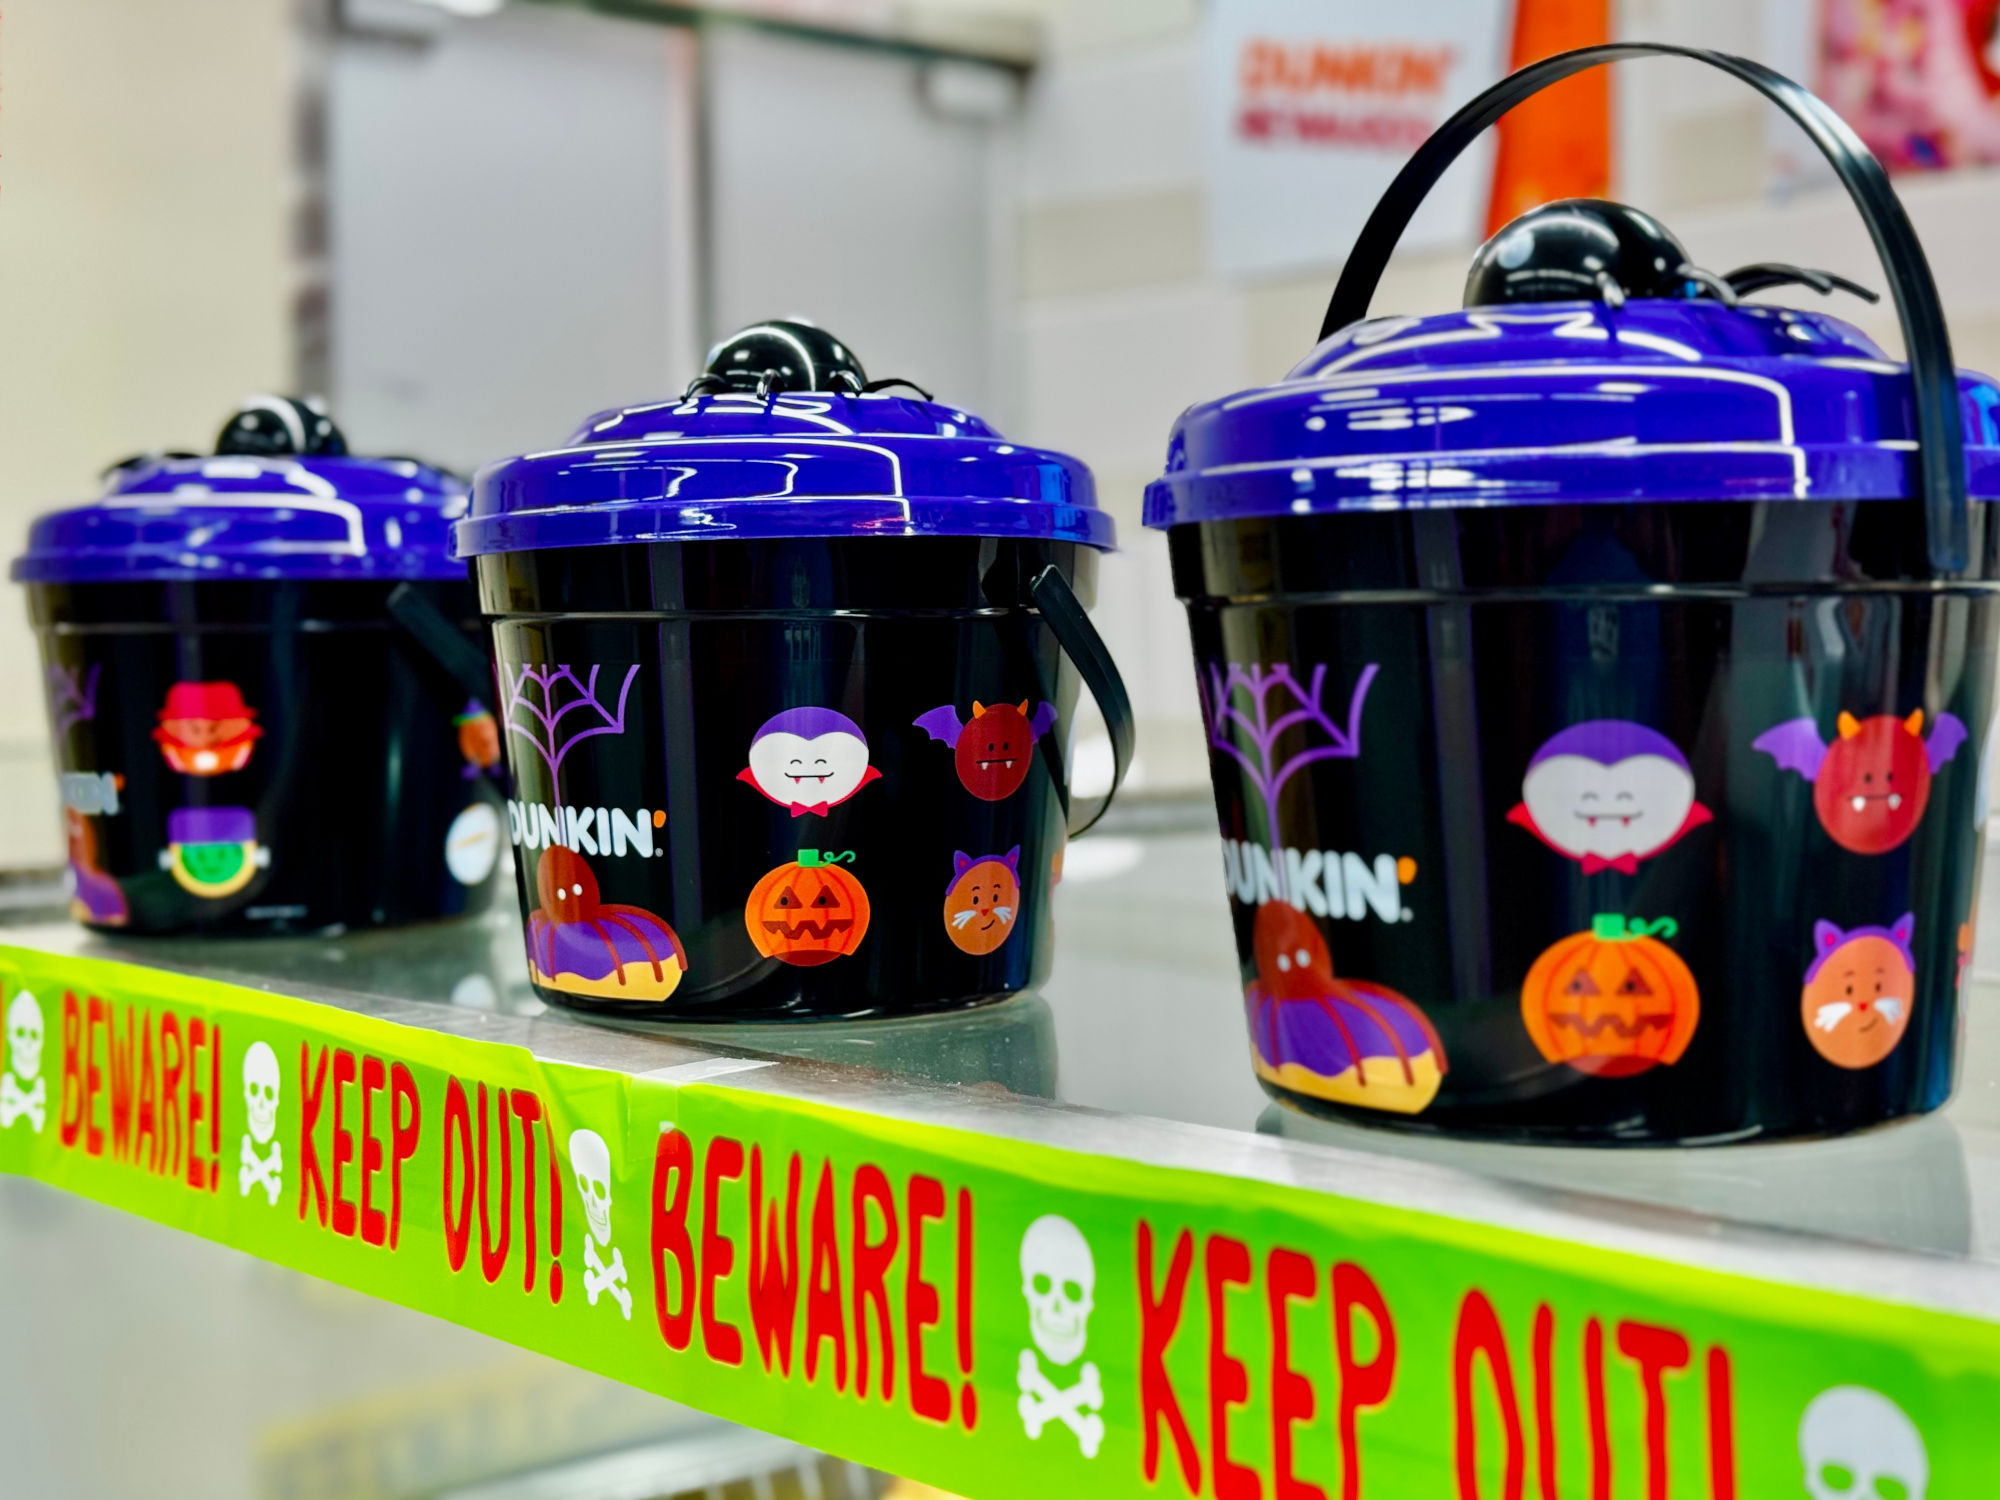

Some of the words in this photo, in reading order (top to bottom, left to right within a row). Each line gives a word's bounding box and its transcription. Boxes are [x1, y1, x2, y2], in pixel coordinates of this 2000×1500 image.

[60, 990, 221, 1193] BEWARE!
[299, 1041, 421, 1252] KEEP
[442, 1075, 563, 1305] OUT!
[651, 1128, 978, 1432] BEWARE!
[1136, 1219, 1397, 1500] KEEP
